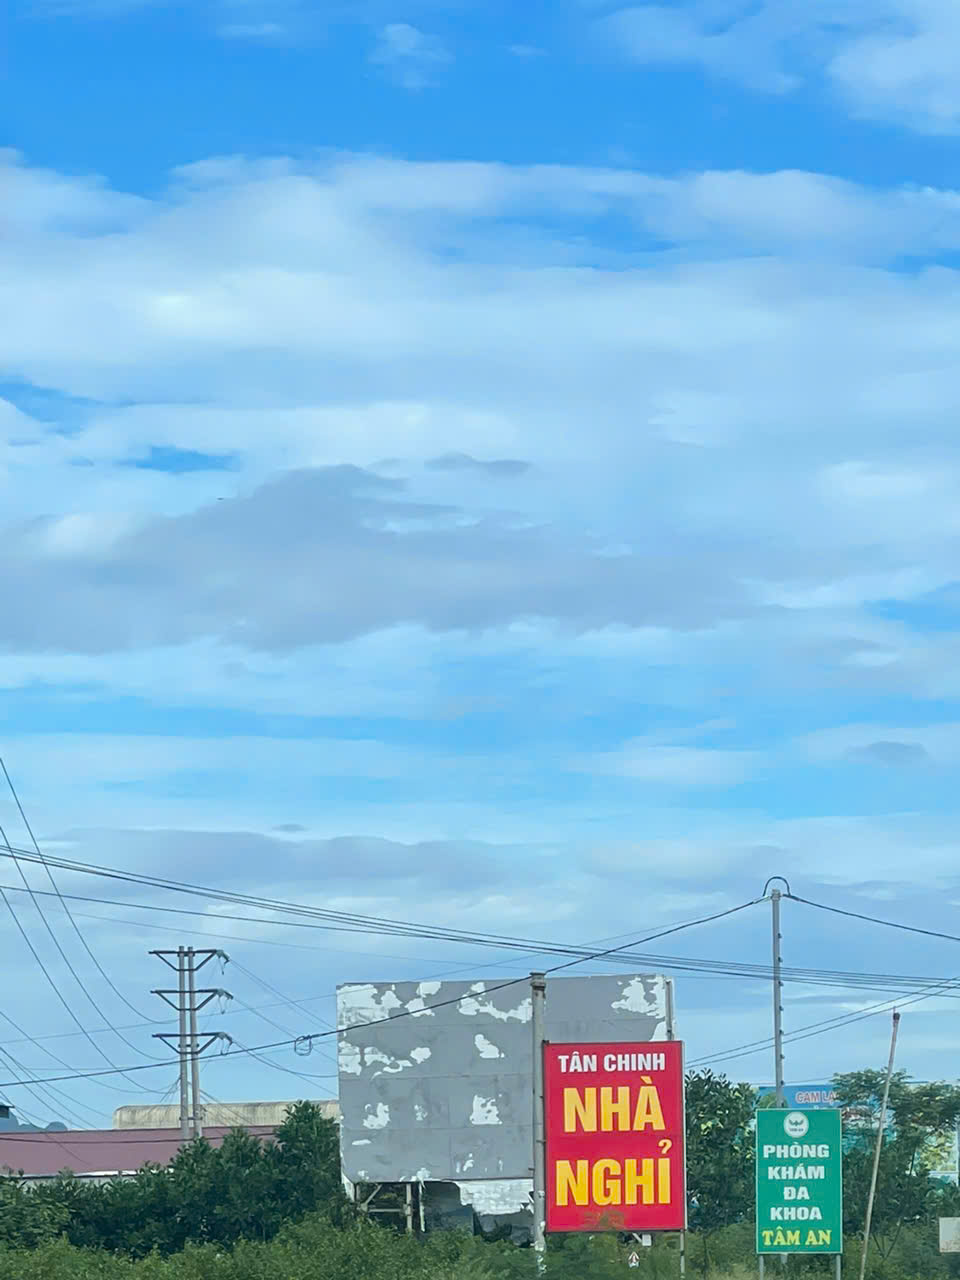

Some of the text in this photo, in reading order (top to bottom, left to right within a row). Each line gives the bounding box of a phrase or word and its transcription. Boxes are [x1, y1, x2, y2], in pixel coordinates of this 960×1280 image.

[558, 1051, 666, 1073] TÂN CHINH
[563, 1076, 666, 1133] NHÀ
[763, 1141, 830, 1159] PHÒNG
[556, 1139, 673, 1206] NGHỈ
[767, 1163, 825, 1180] KHÁM
[783, 1186, 810, 1200] ĐA
[770, 1207, 823, 1221] KHOA
[762, 1226, 832, 1246] TÂM AN
